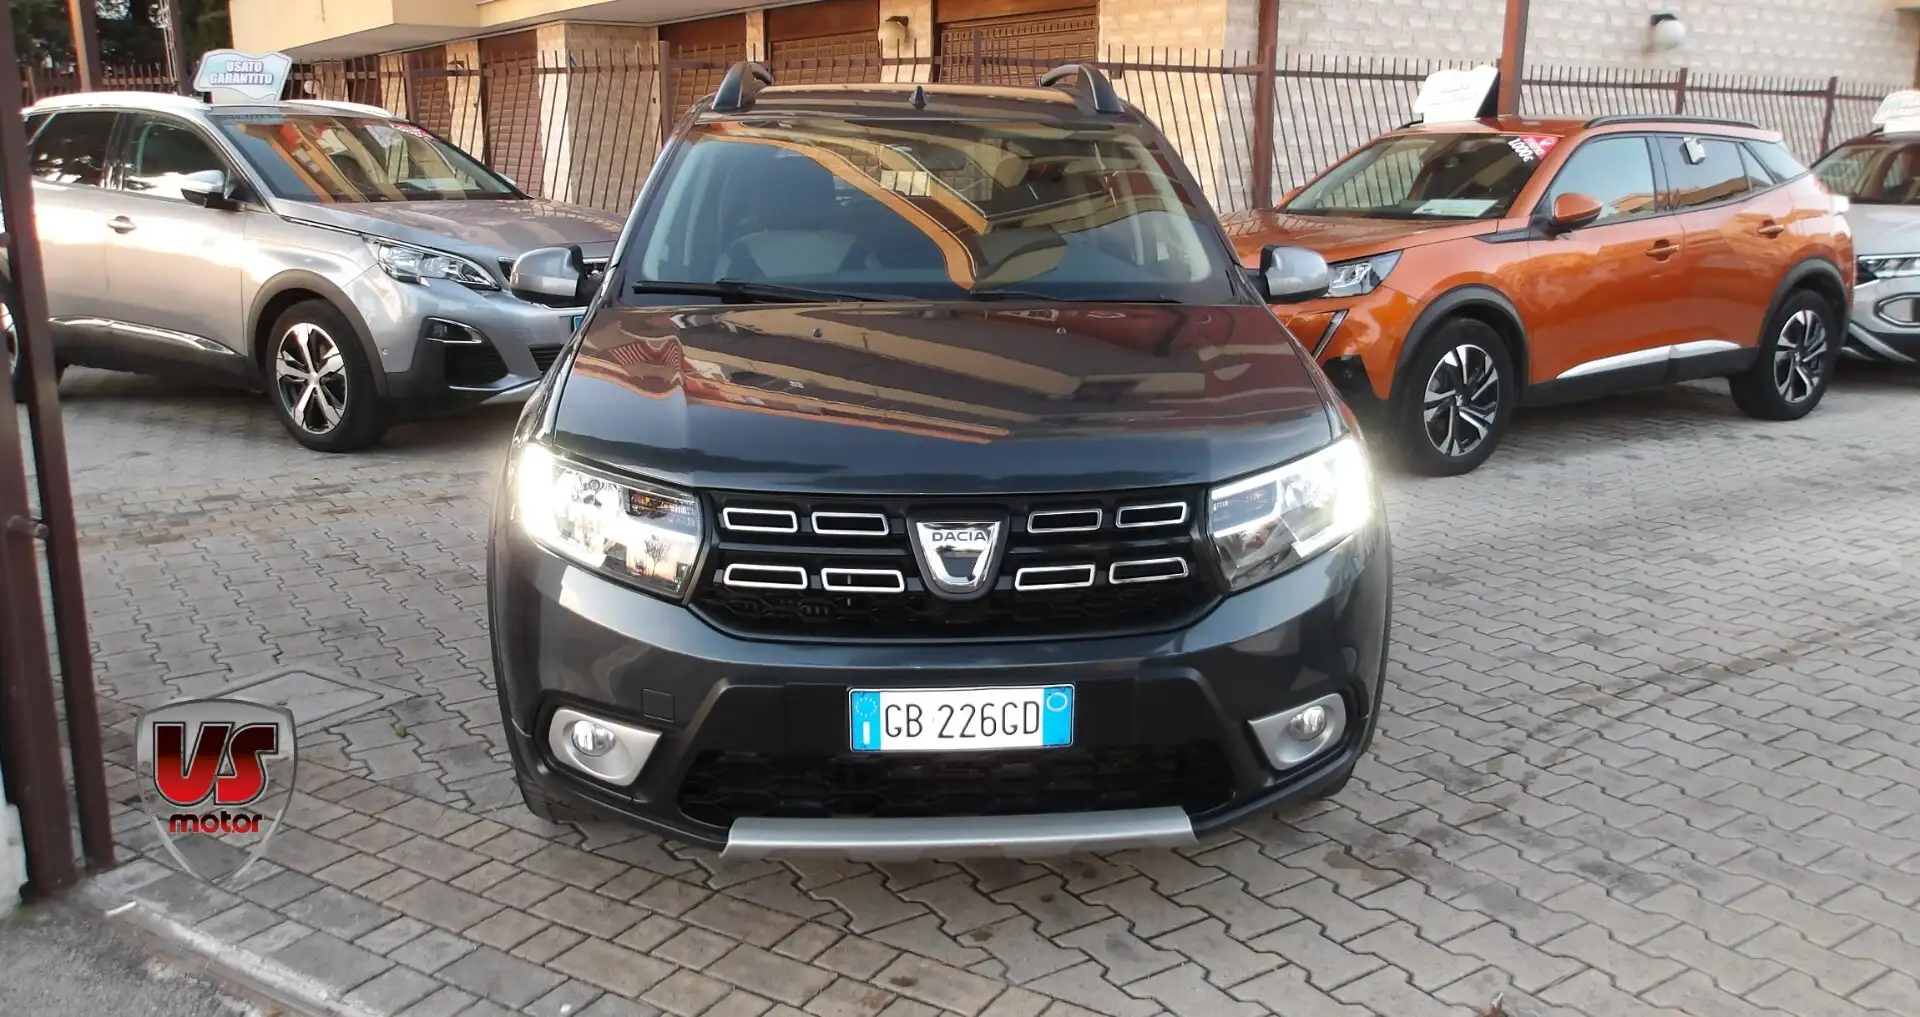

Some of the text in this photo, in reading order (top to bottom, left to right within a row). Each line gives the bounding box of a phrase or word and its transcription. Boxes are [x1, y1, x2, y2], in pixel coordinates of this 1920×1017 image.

[226, 61, 263, 73] USATO
[209, 73, 274, 85] GARANTITO
[931, 531, 987, 542] DACIA
[885, 701, 1041, 738] GB 226GD
